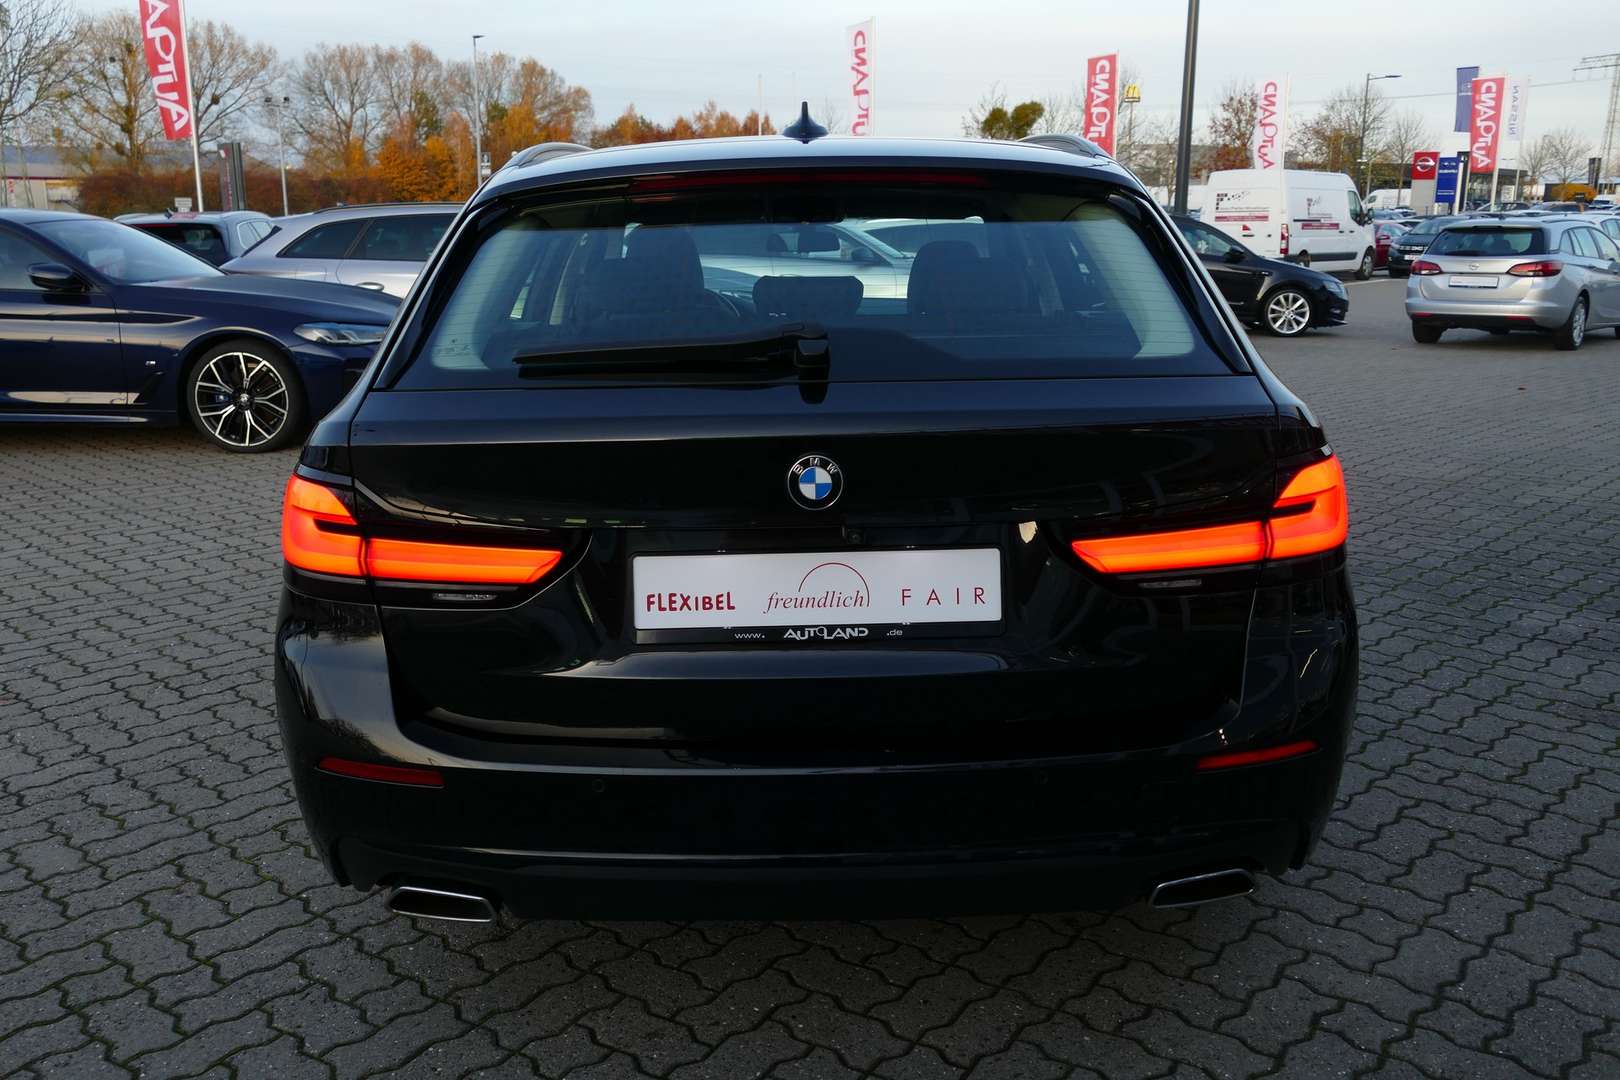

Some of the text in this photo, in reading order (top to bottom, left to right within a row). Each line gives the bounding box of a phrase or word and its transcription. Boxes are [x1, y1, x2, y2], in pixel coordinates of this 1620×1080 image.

[793, 457, 838, 475] BMW
[646, 587, 987, 615] FLEXIBEL freundlich FAIR
[783, 626, 870, 641] AUTOLAND
